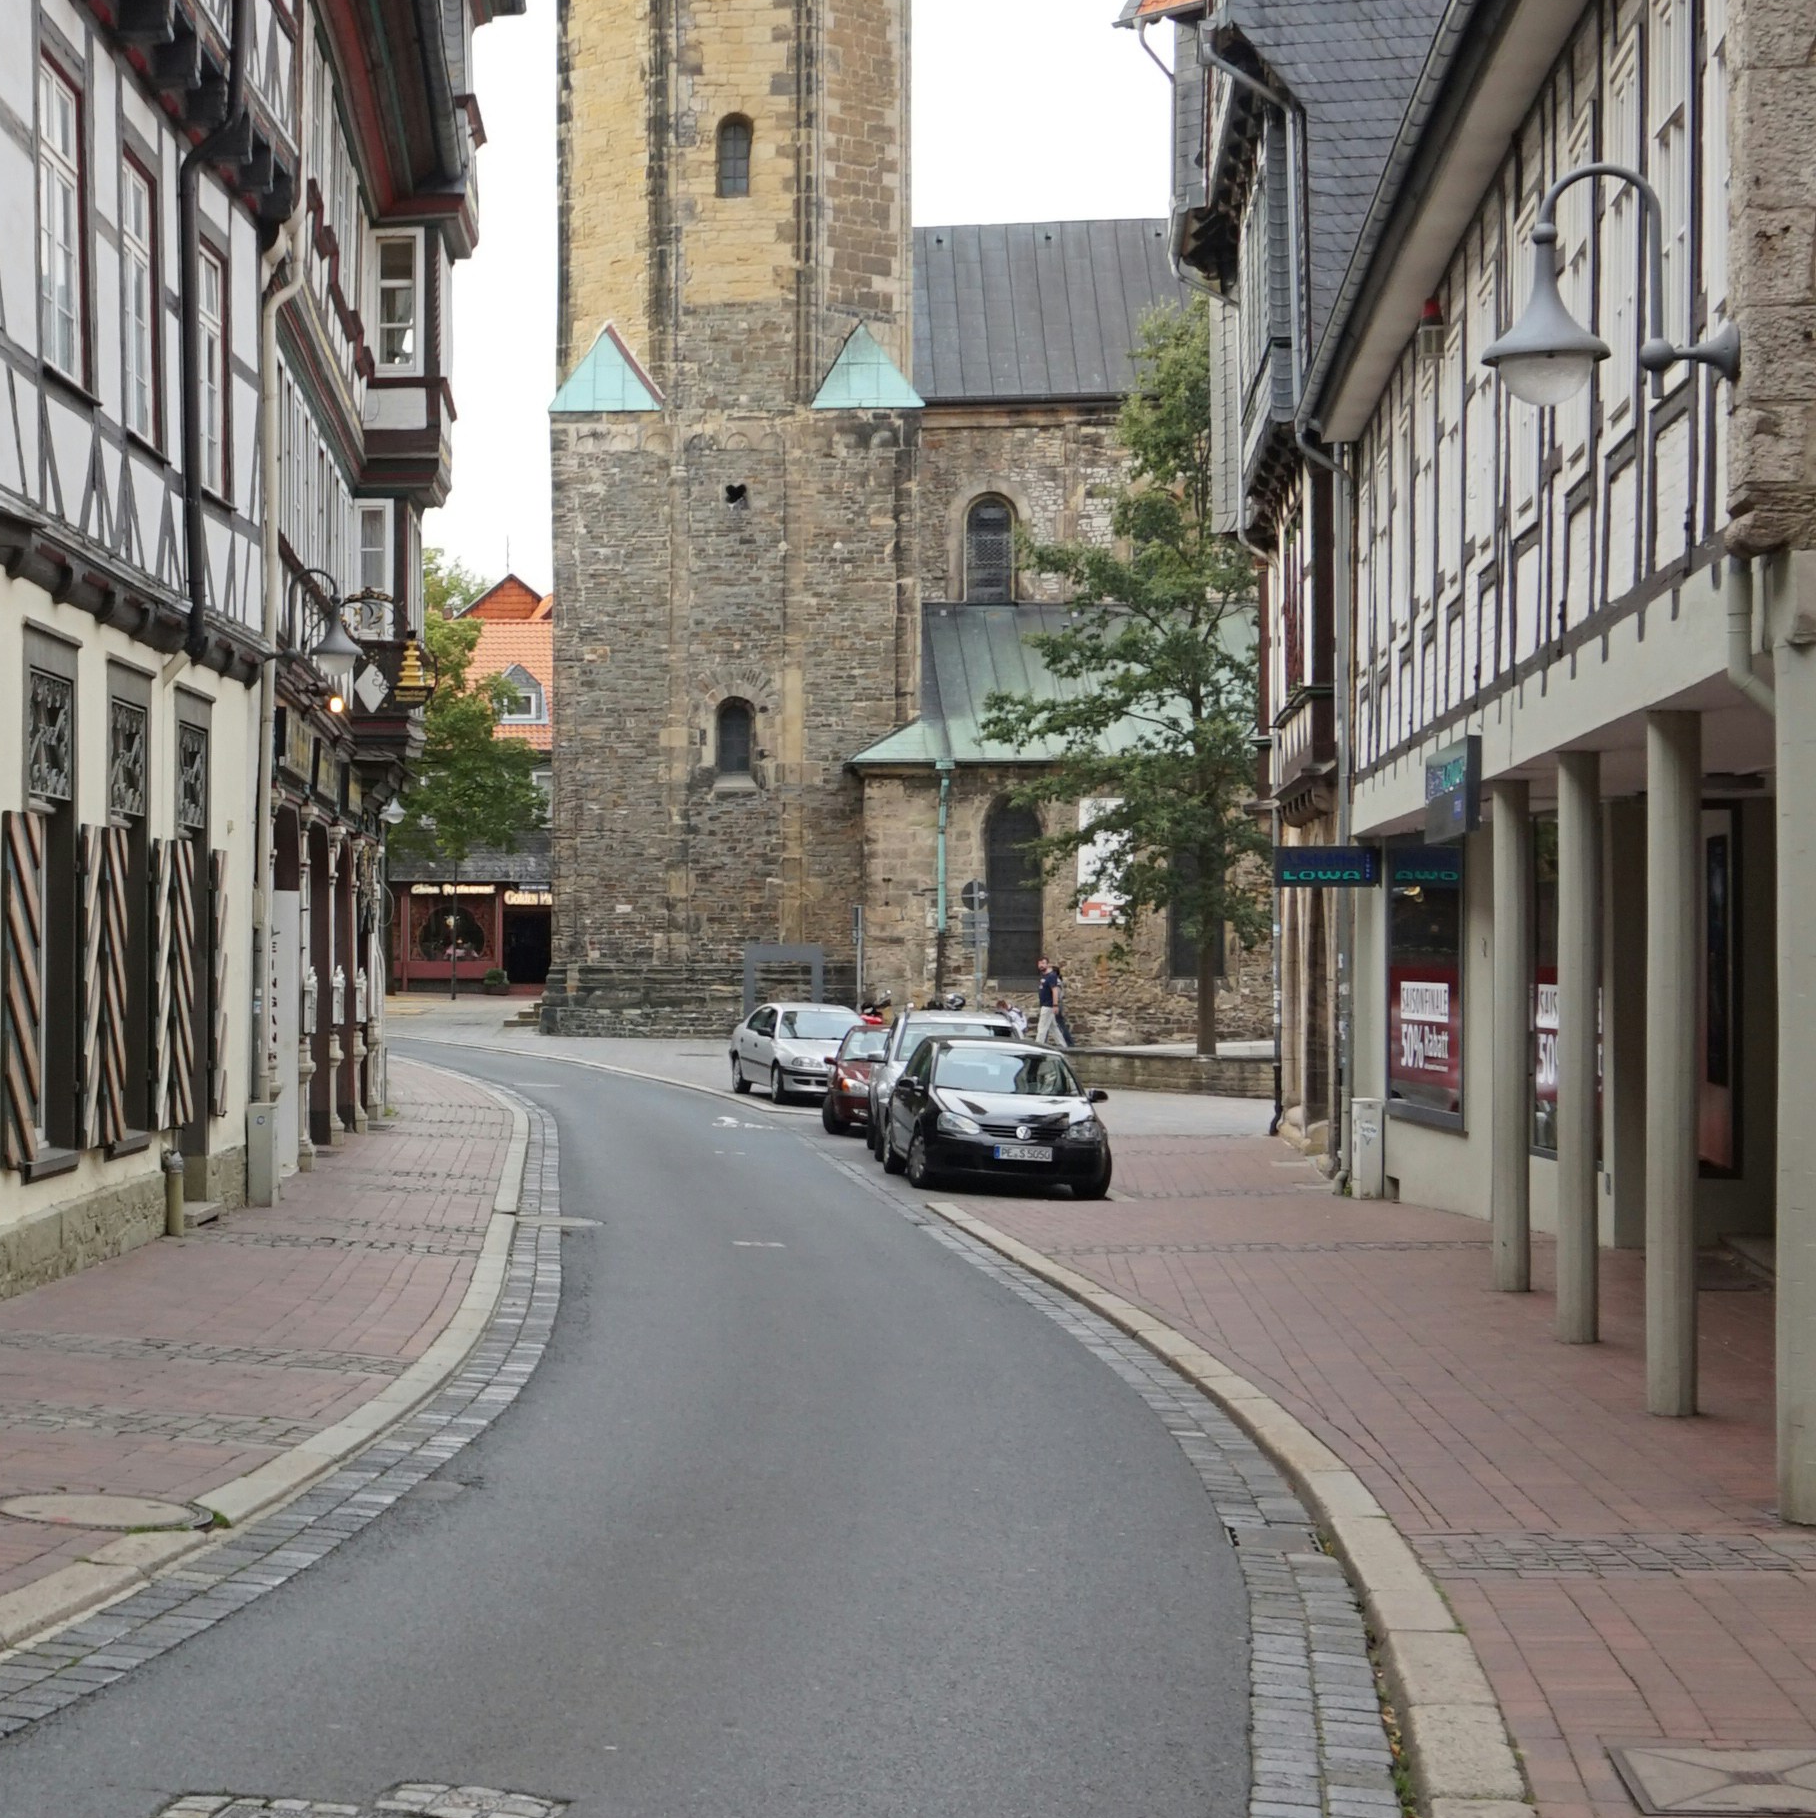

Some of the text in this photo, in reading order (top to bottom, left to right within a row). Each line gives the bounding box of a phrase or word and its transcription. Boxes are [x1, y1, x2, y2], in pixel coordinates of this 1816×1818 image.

[442, 883, 497, 896] Restaurant
[1283, 870, 1361, 881] LOWA
[1401, 986, 1449, 1016] SAISONFINALE
[1540, 990, 1559, 1018] SAIS
[1400, 1023, 1449, 1069] 50% Rabatt
[1538, 1033, 1559, 1085] 50
